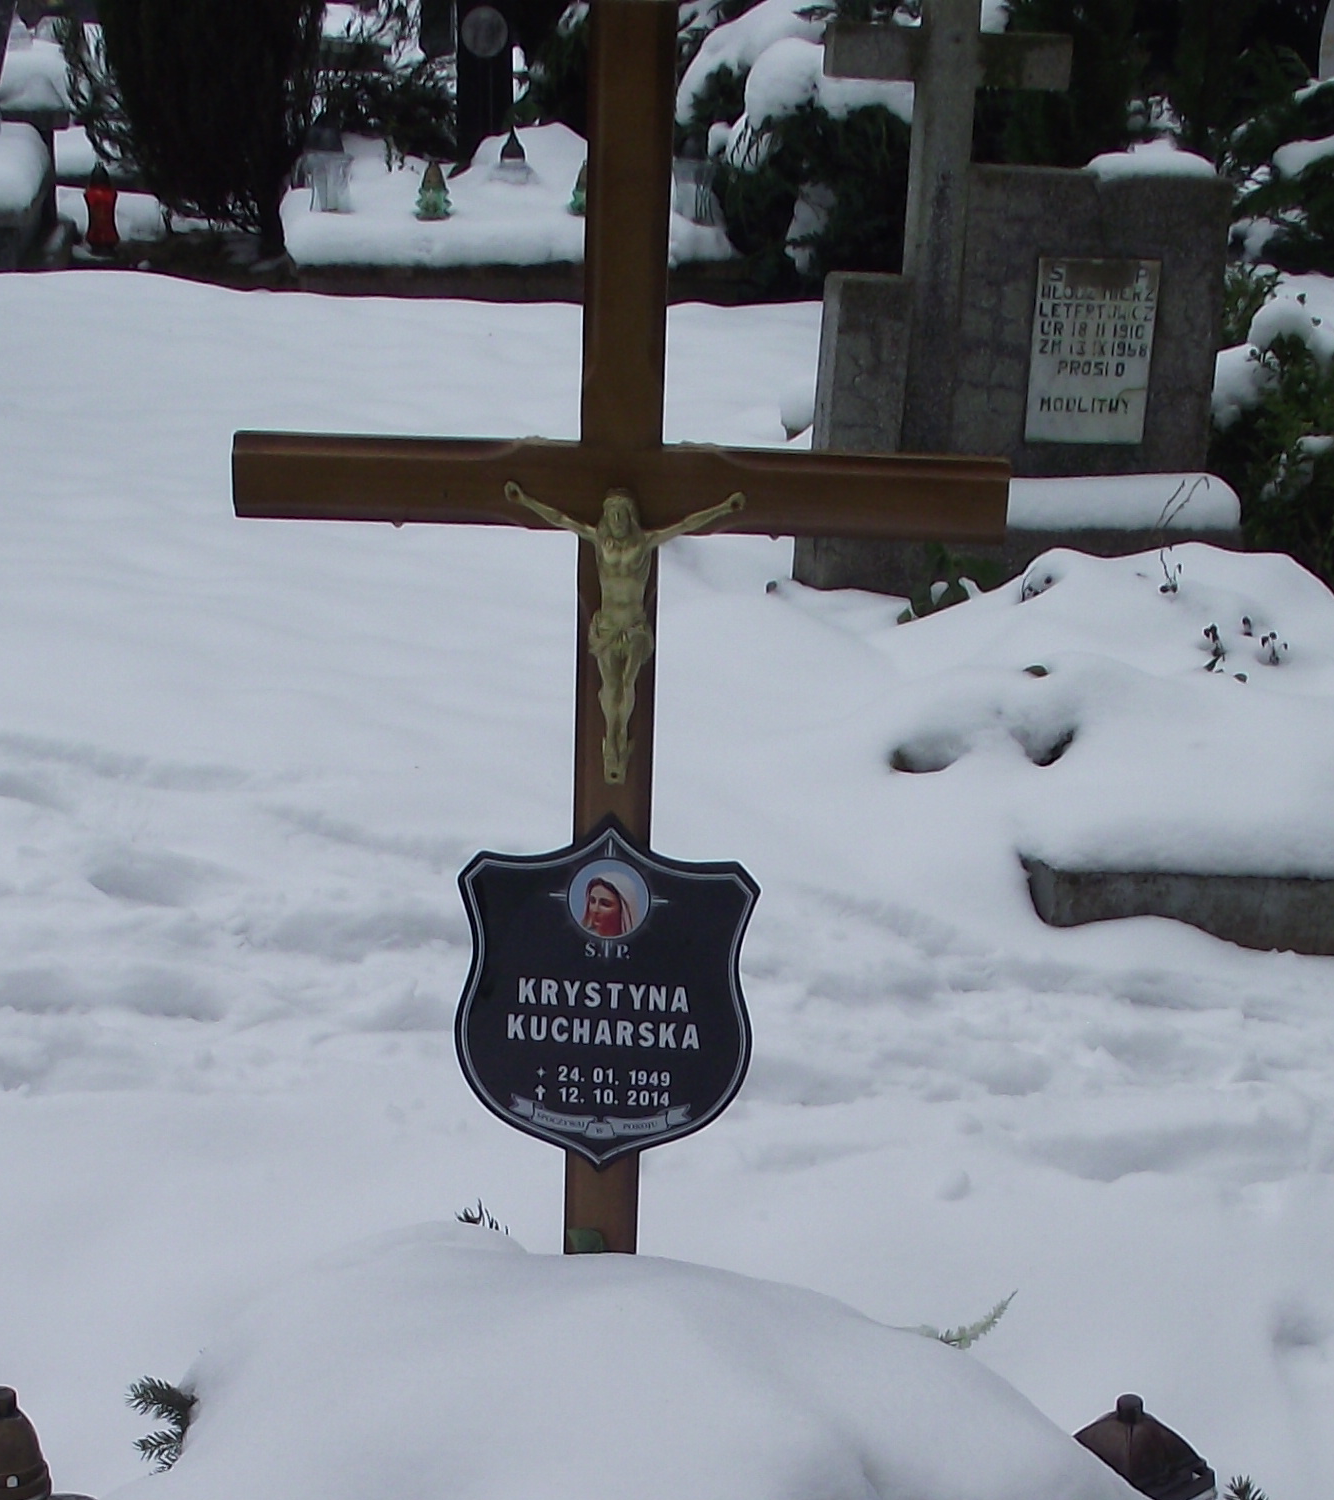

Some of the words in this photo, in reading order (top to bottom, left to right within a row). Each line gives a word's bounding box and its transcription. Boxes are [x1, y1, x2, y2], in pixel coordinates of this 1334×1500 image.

[517, 976, 690, 1014] KRYSTYNA
[506, 1013, 701, 1050] KUCHARSKA
[557, 1065, 585, 1082] 24.
[592, 1067, 619, 1085] 01.
[628, 1069, 671, 1087] 1949
[558, 1086, 585, 1103] 12.
[592, 1088, 619, 1105] 10.
[627, 1090, 670, 1107] 2014
